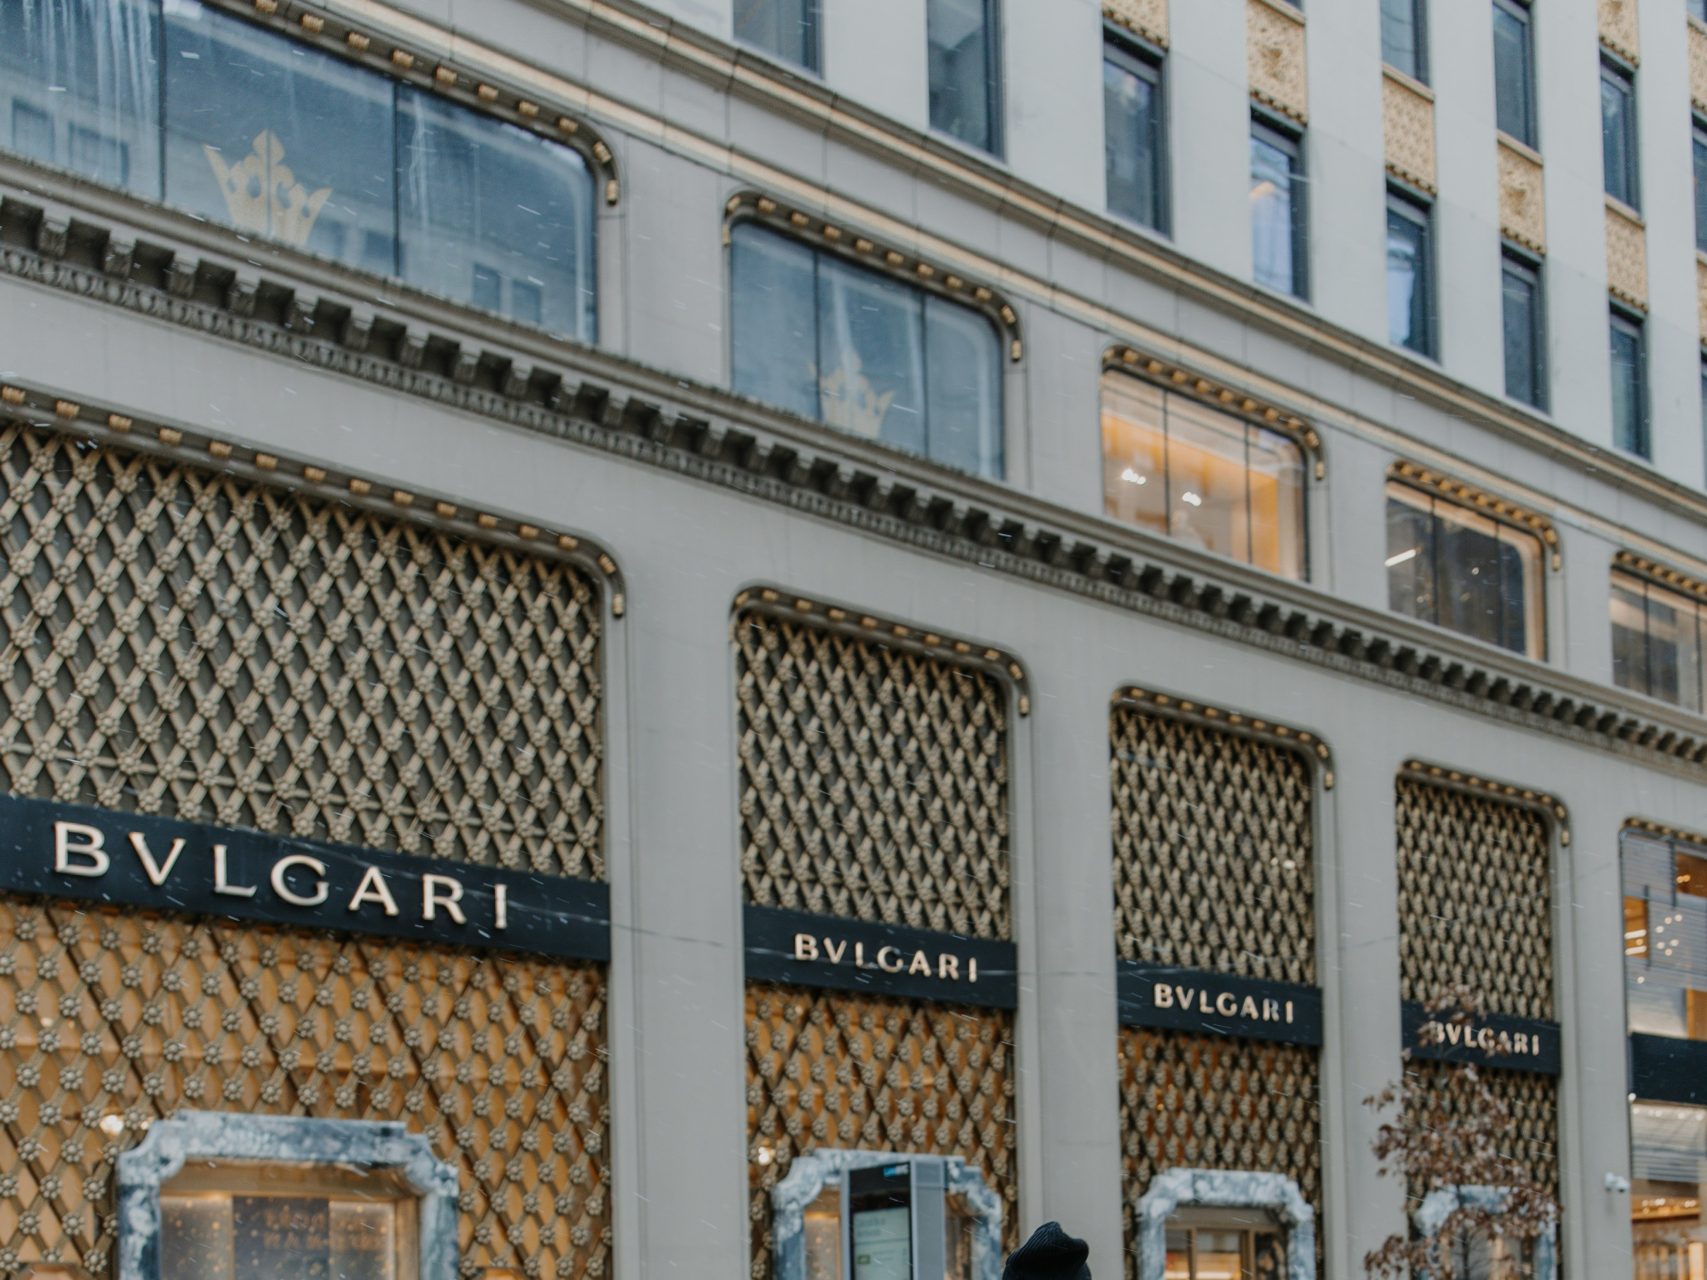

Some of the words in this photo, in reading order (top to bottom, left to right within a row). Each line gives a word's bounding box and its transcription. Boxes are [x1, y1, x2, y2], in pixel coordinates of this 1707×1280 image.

[54, 820, 508, 930] BVLGARI
[794, 933, 978, 983] BVLGARI
[1153, 983, 1294, 1024] BVLGARI
